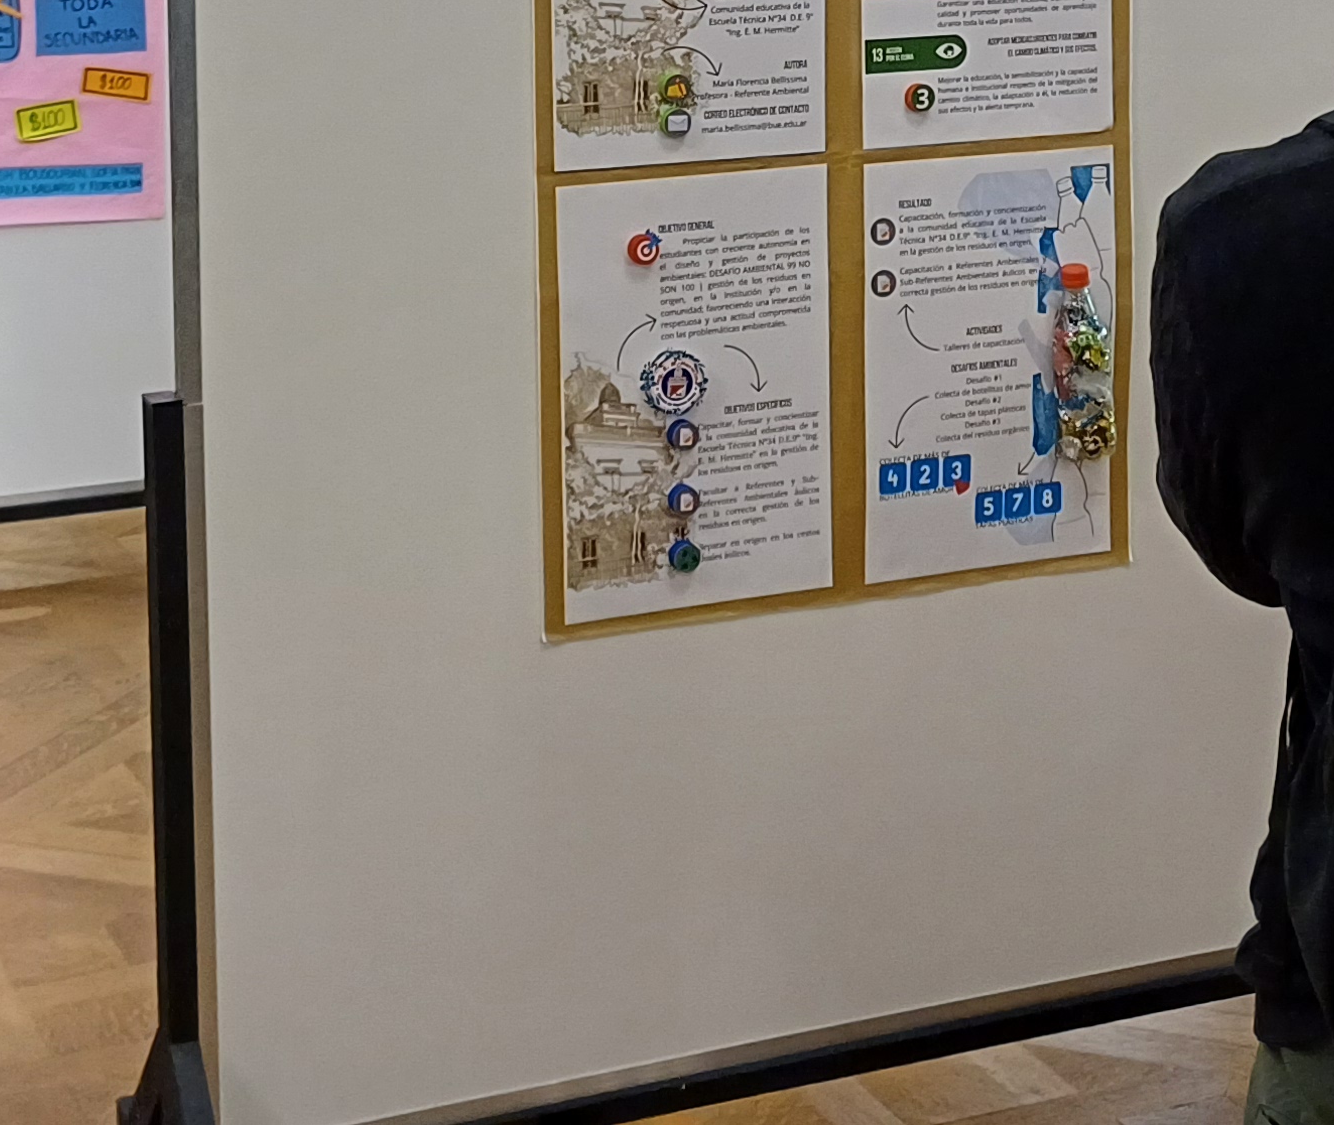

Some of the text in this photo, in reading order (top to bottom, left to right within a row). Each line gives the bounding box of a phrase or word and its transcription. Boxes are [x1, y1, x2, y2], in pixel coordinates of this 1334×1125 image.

[711, 4, 754, 14] Comunidad
[77, 16, 97, 29] LA
[709, 17, 737, 25] Escuela
[872, 48, 883, 62] 13
[772, 87, 809, 95] Ambiental
[916, 89, 929, 109] 3
